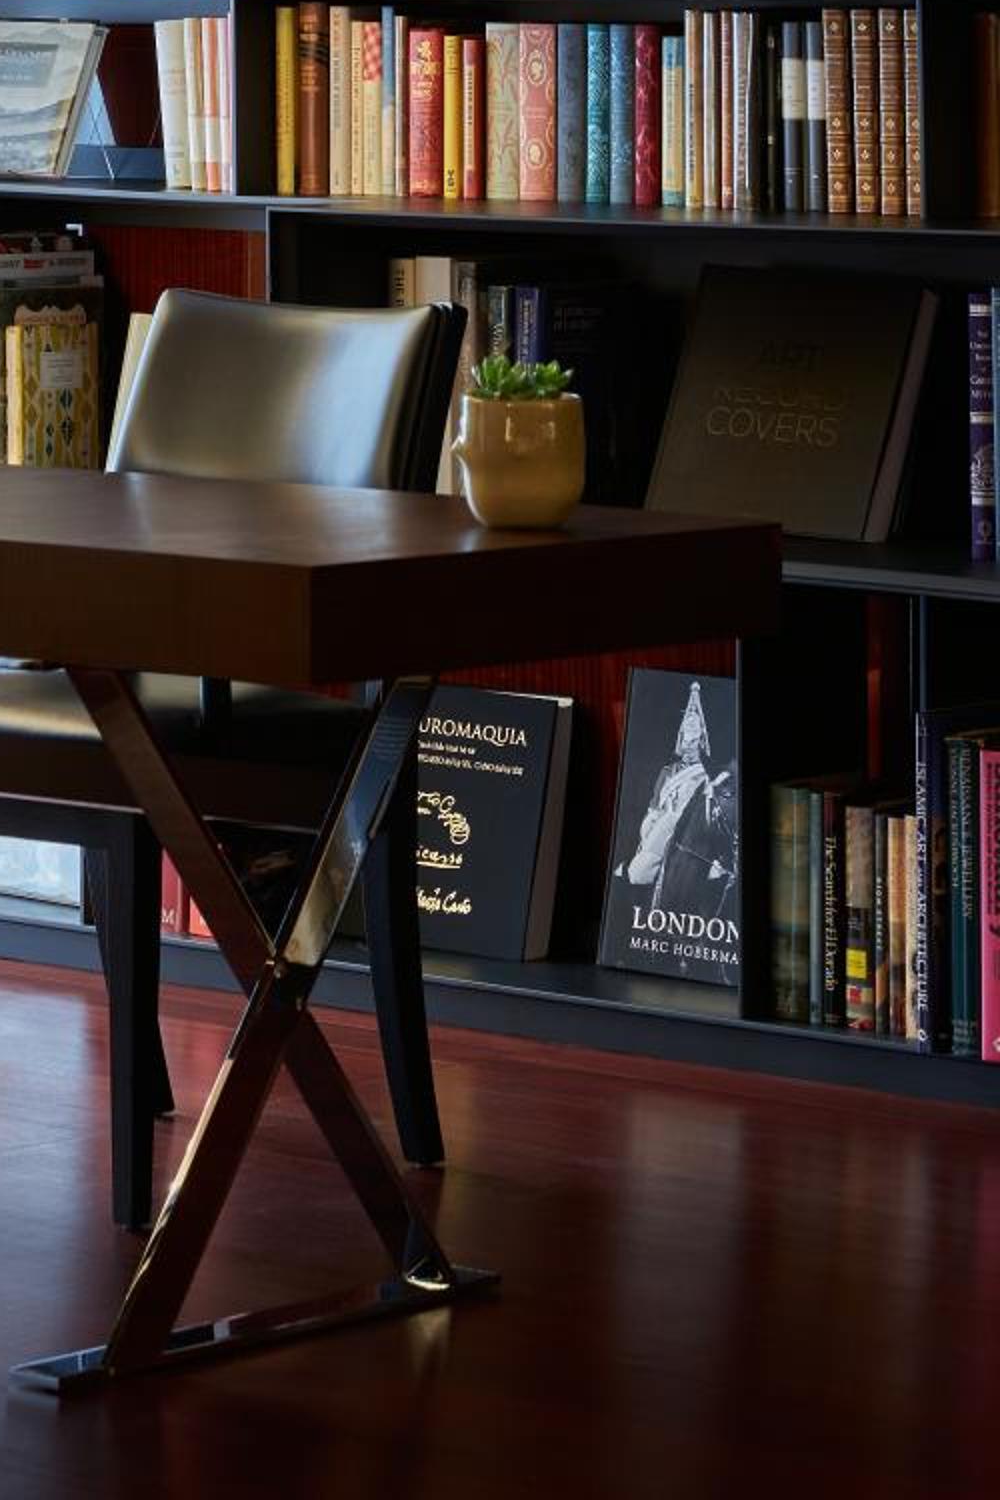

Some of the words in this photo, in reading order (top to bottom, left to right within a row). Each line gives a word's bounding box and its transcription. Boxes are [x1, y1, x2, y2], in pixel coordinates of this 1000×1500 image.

[706, 407, 840, 448] COVERS
[418, 717, 528, 748] UROMAQUIA
[915, 760, 927, 826] ISLAMIC
[822, 835, 837, 862] The
[916, 830, 927, 865] ART
[822, 863, 838, 903] Search
[631, 905, 739, 944] LONDON
[629, 937, 669, 954] MARC
[672, 942, 740, 966] HOBERMA
[824, 943, 838, 992] Dorado
[916, 891, 929, 1012] ARCHITECTURE
